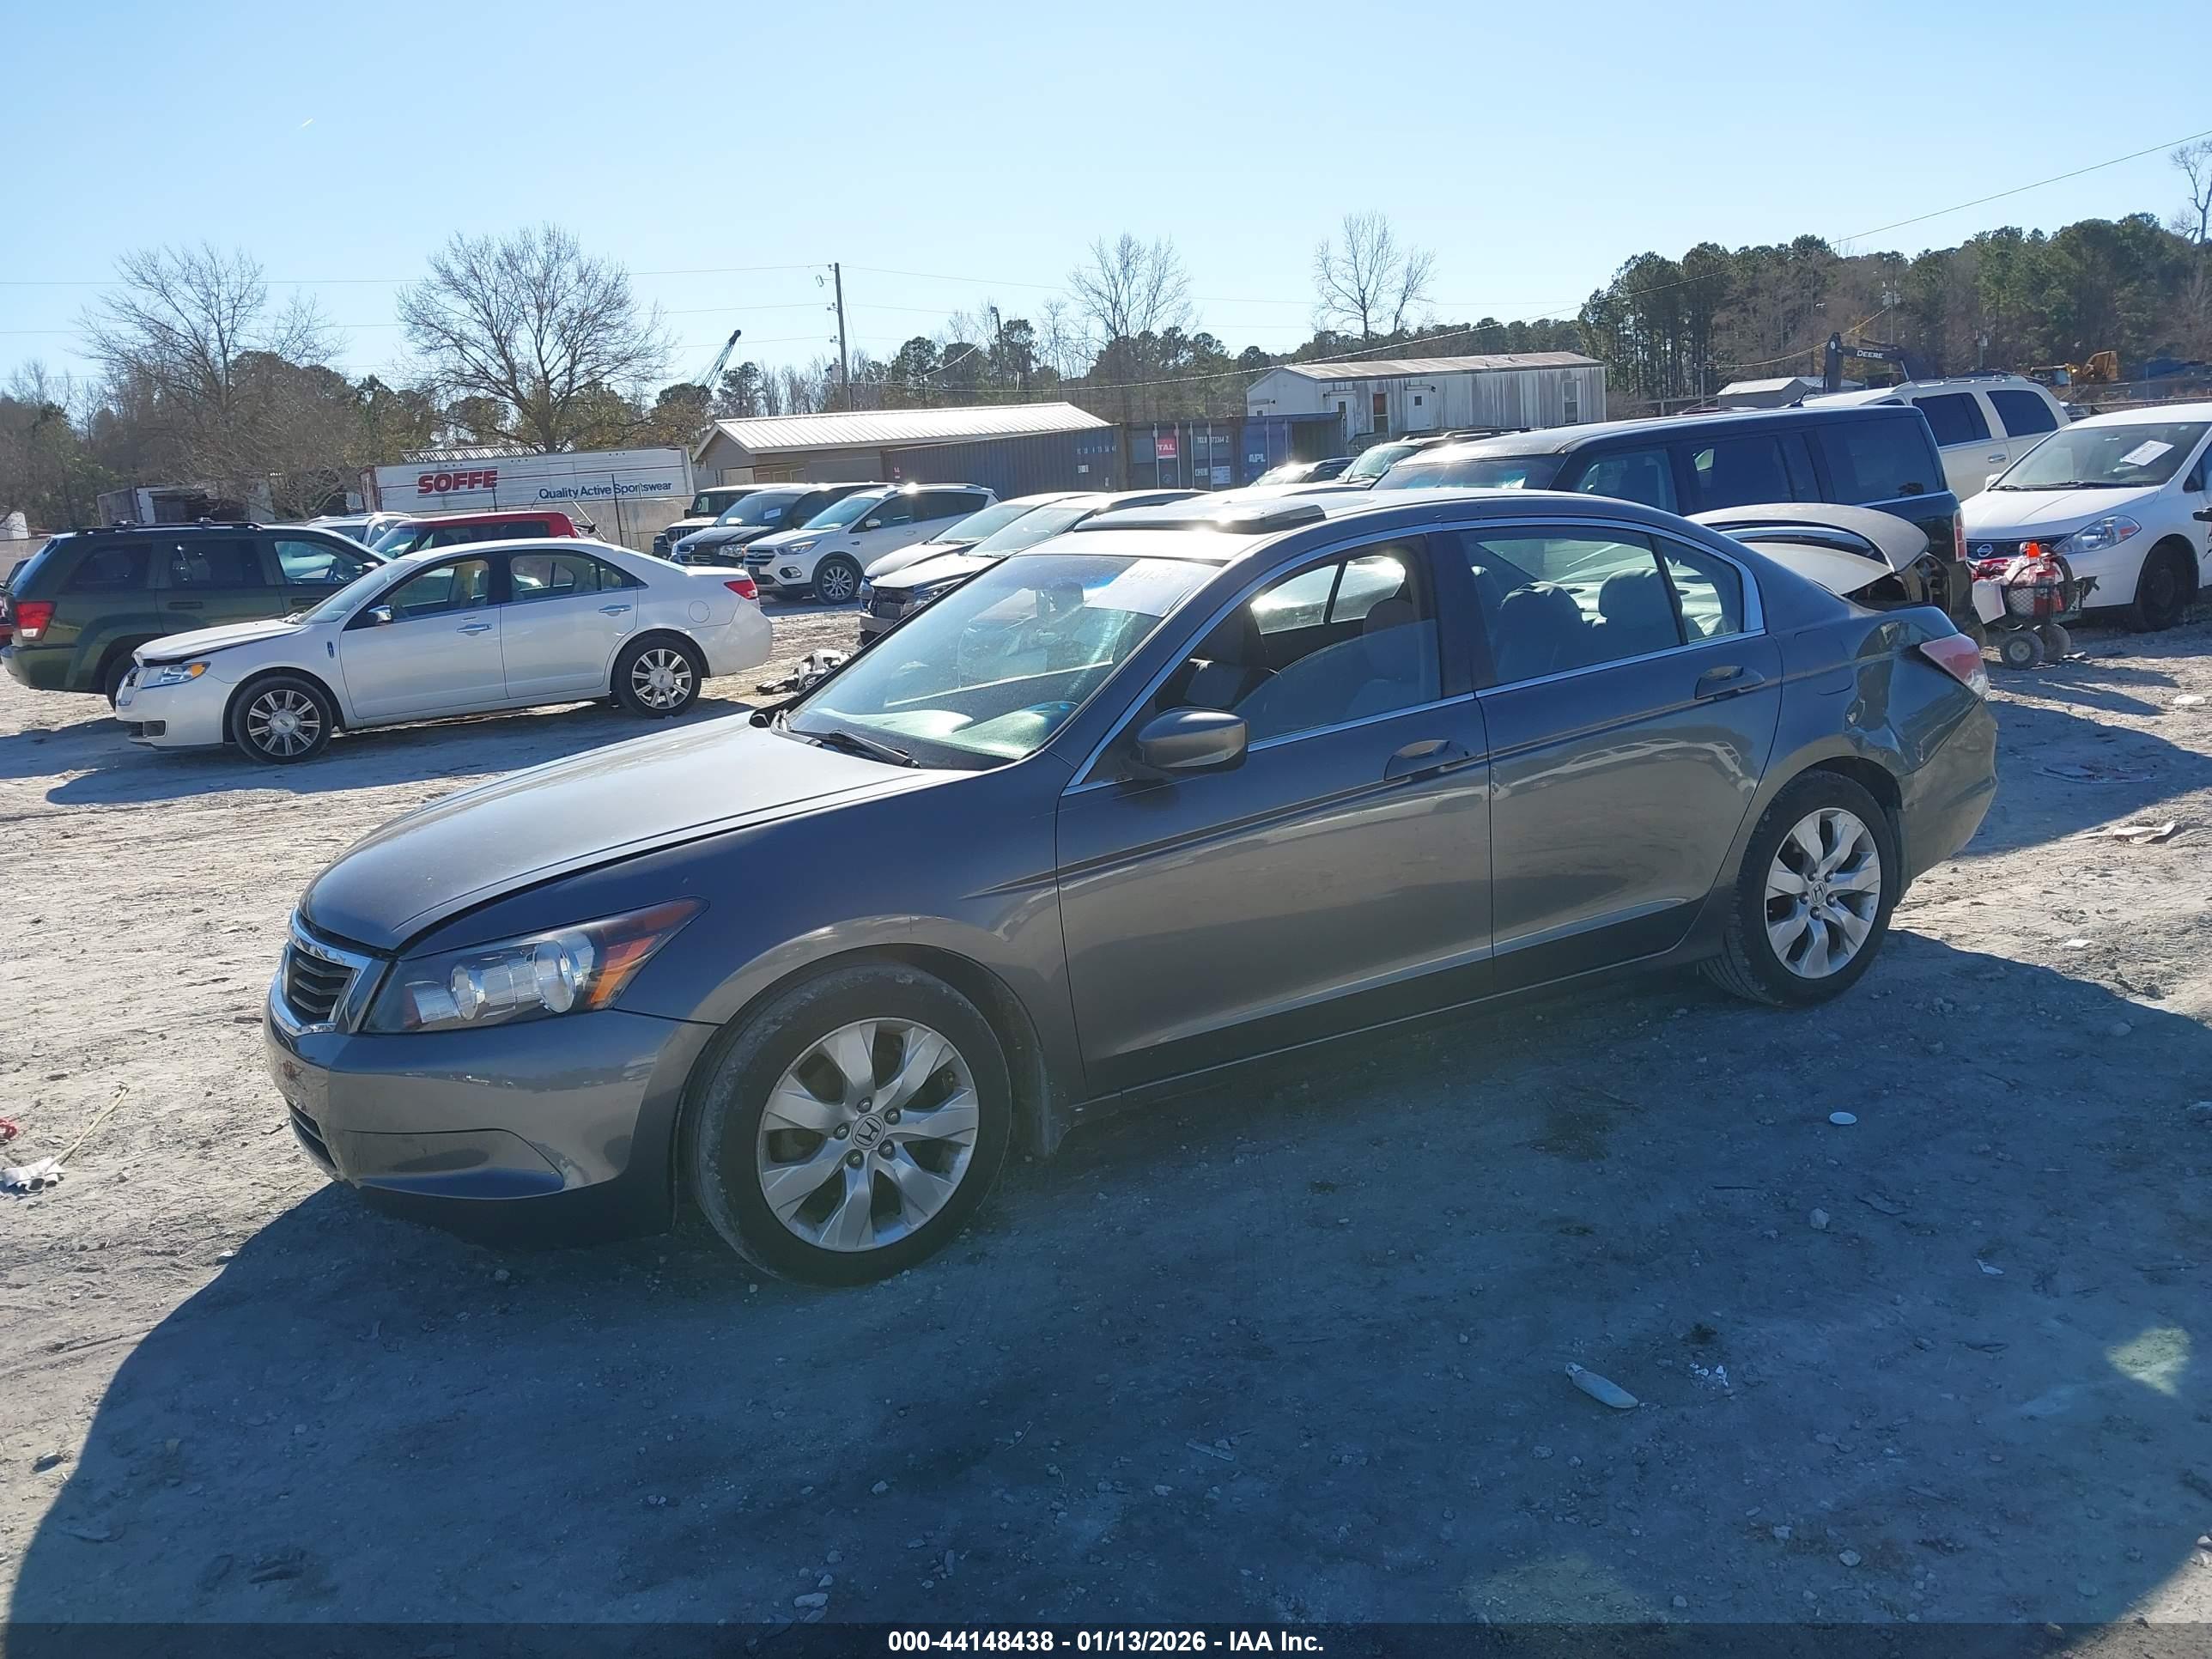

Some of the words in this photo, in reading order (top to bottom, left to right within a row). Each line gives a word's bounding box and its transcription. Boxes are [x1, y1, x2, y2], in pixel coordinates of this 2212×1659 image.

[1856, 349, 1883, 358] DEERE
[416, 470, 498, 494] SOFFE
[539, 488, 578, 499] Quality
[581, 484, 611, 495] Active
[613, 483, 672, 495] Sportswear
